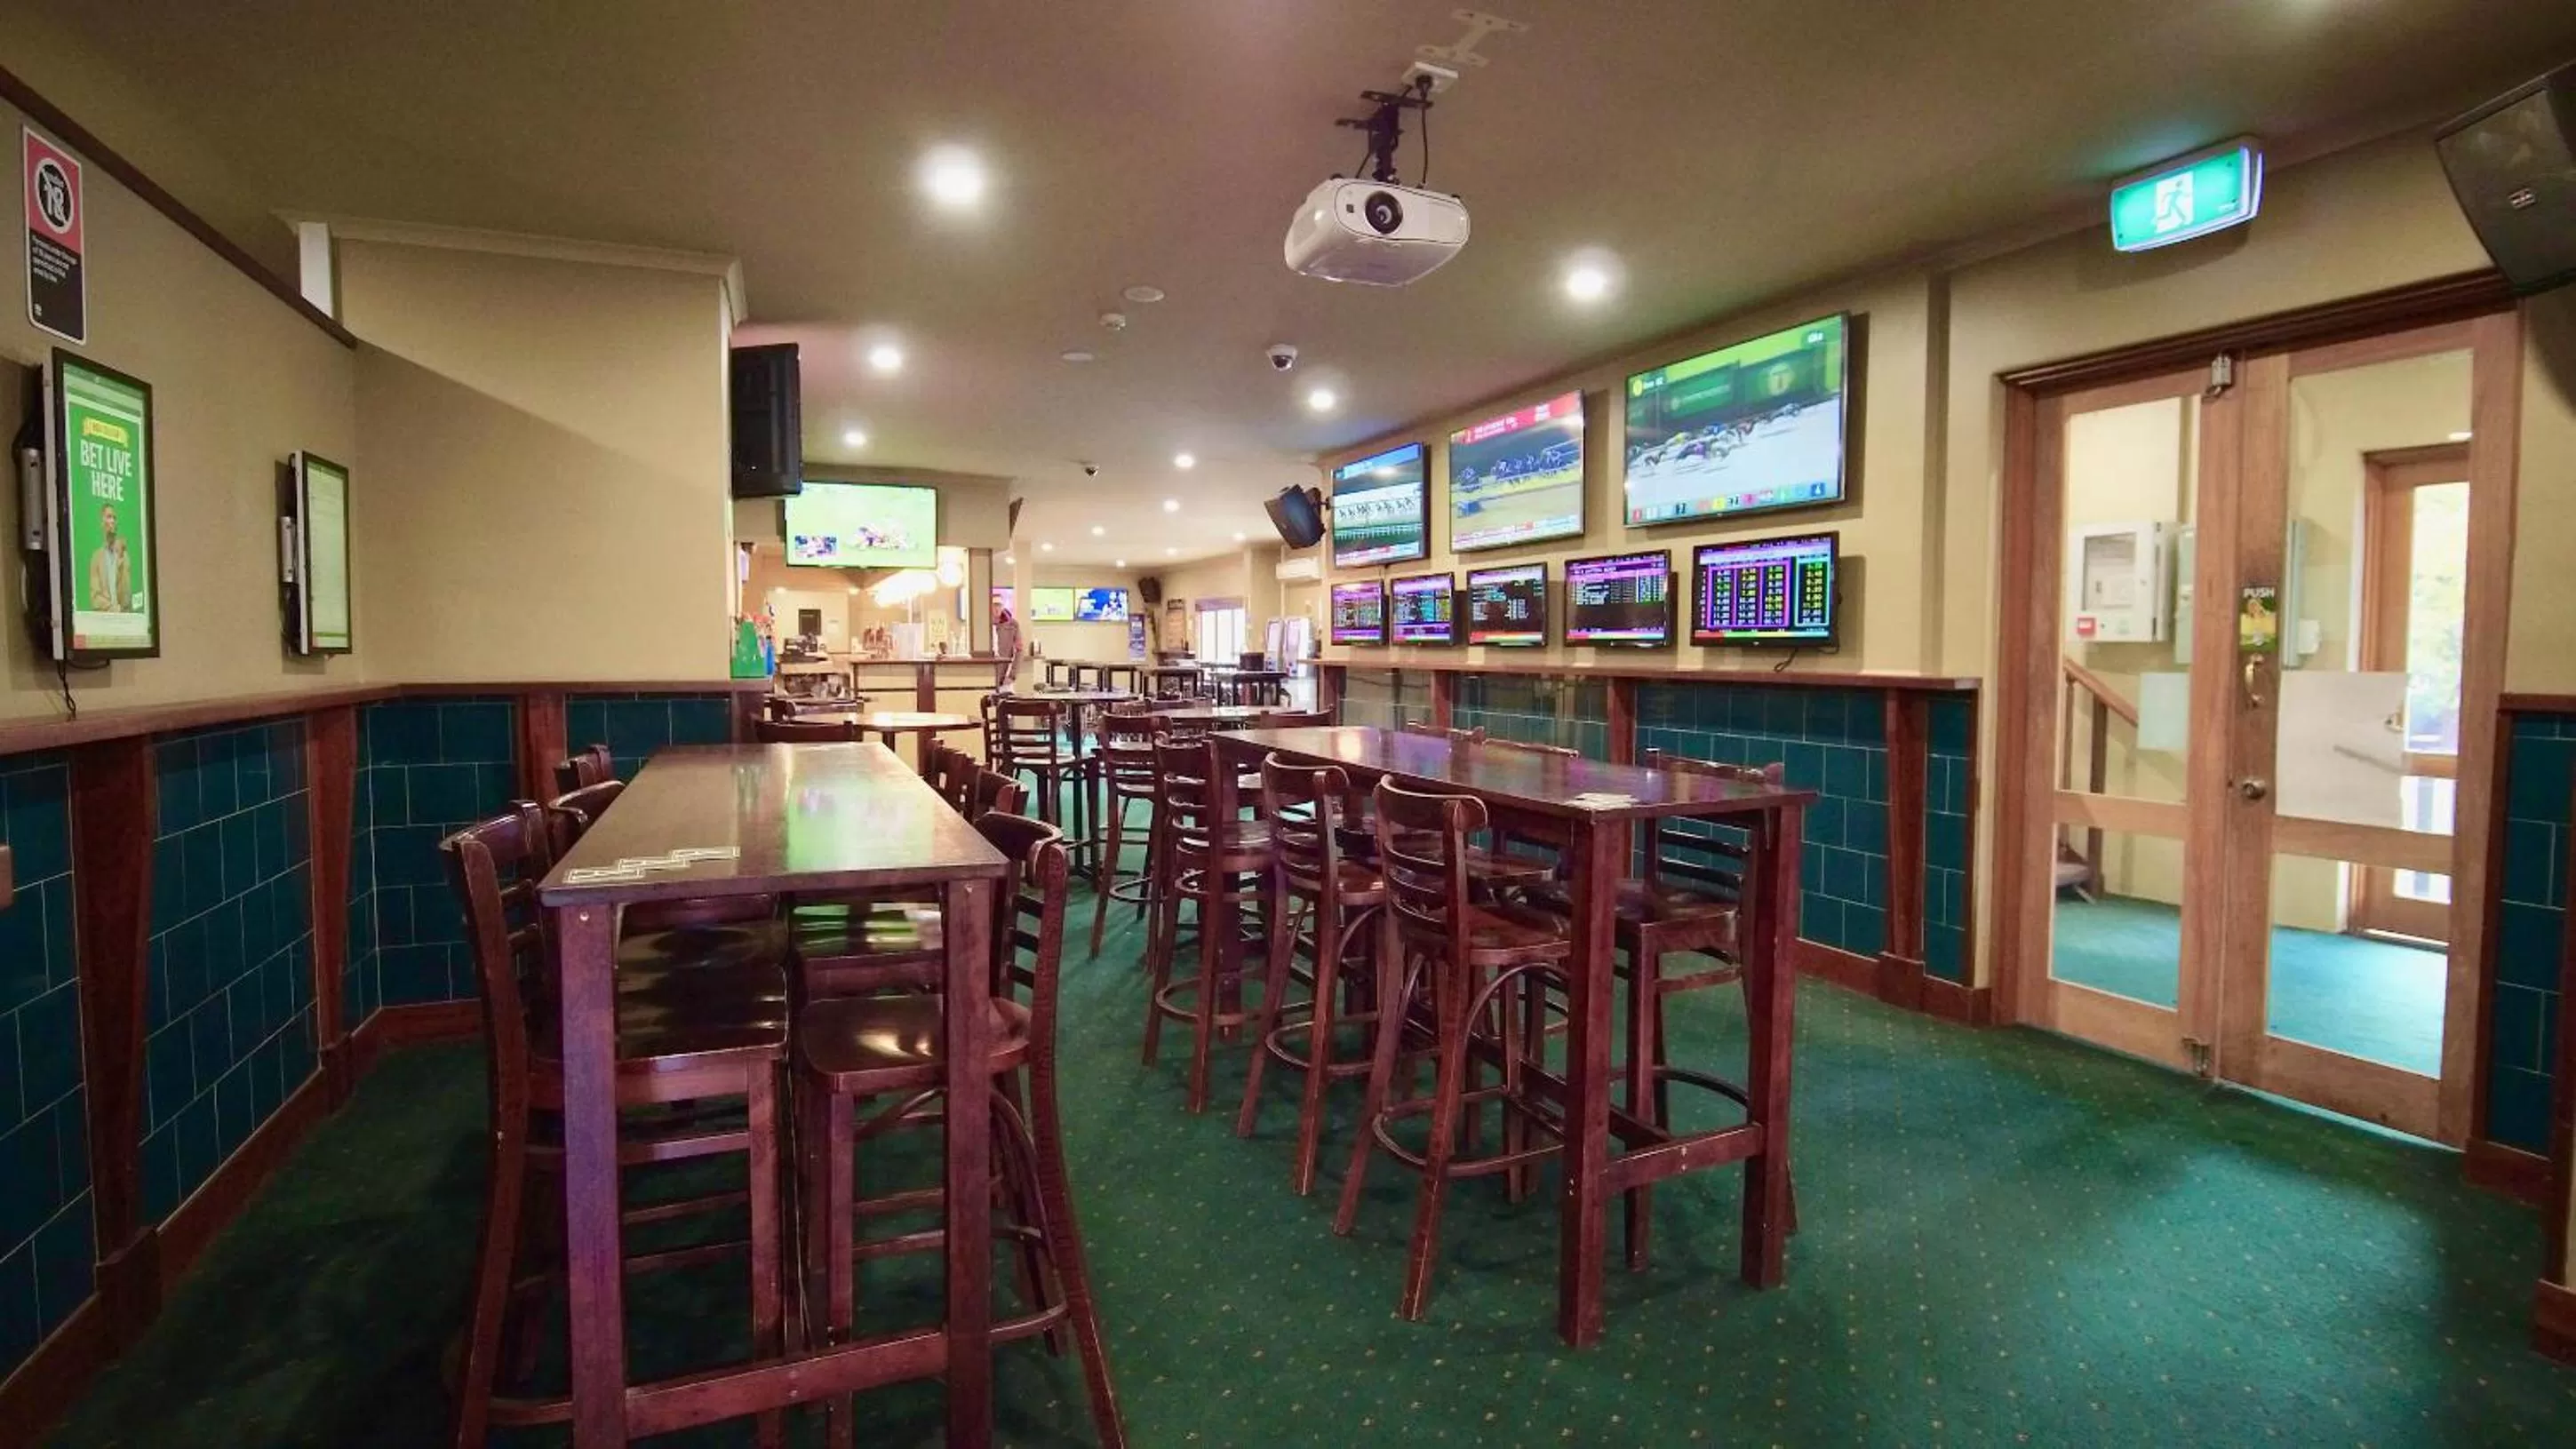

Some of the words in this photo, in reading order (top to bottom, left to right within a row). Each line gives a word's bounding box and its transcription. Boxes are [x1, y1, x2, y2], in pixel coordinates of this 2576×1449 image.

[80, 439, 103, 470] BET
[106, 447, 132, 477] LIVE
[92, 470, 124, 502] HERE
[2244, 586, 2275, 598] PUSH
